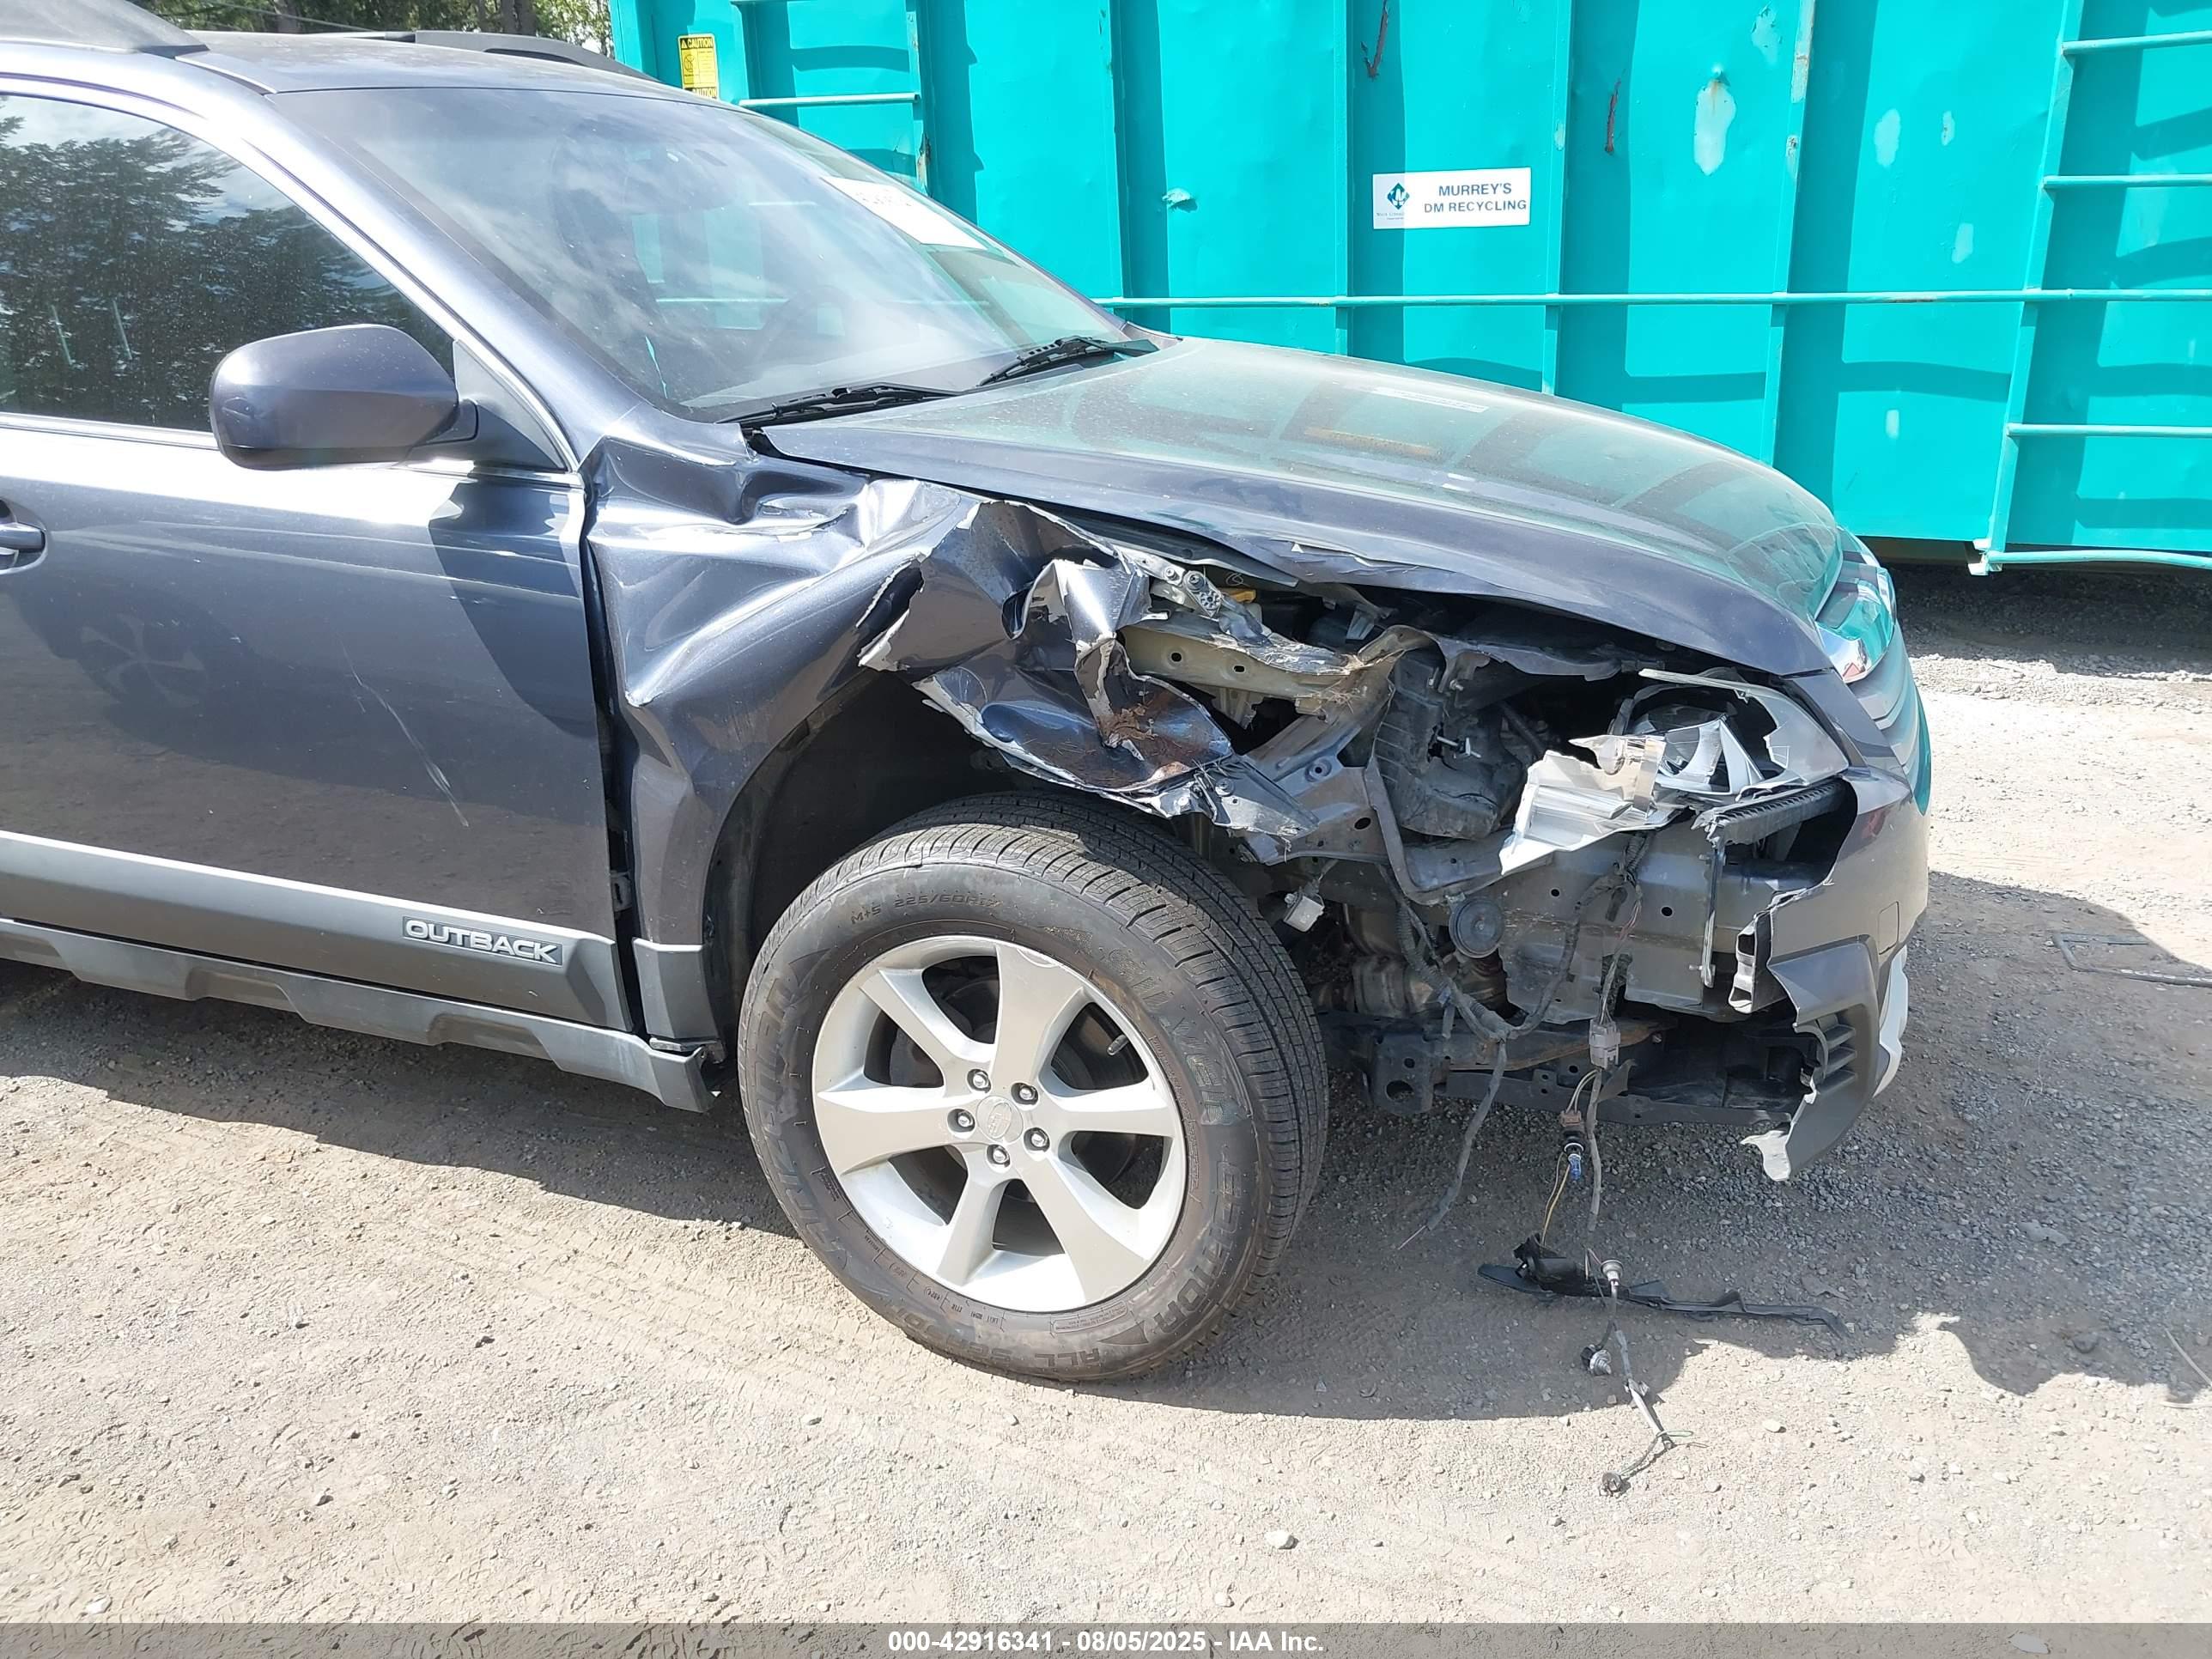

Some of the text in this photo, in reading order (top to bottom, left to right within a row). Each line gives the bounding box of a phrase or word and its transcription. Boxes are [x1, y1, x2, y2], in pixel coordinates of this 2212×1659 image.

[688, 38, 714, 48] CAUTION
[1438, 182, 1512, 197] MURREY'S
[1424, 199, 1527, 214] DM RECYCLING
[850, 903, 881, 925] M+S
[405, 919, 558, 963] OUTBACK
[1035, 1348, 1100, 1368] ALL
